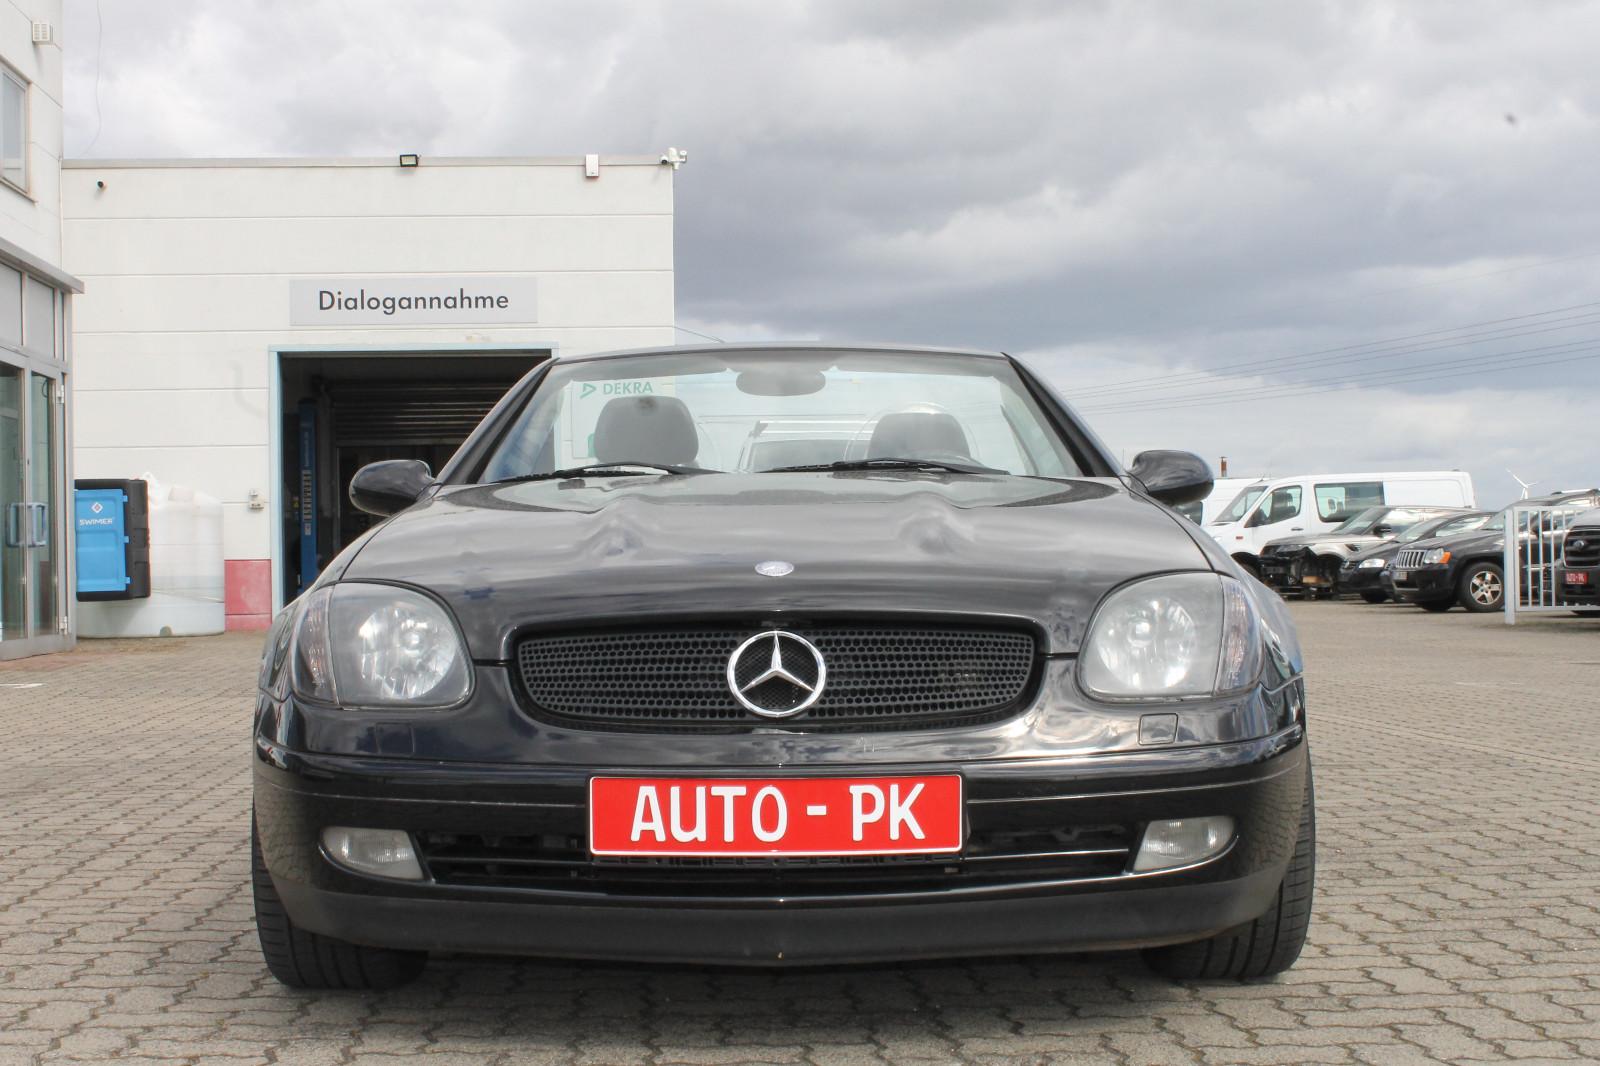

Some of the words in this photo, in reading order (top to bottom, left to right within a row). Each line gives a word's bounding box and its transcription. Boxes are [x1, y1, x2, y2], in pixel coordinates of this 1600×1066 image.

[318, 287, 510, 316] Dialogannahme
[602, 382, 654, 396] DEKRA
[630, 784, 788, 844] AUTO
[848, 782, 927, 842] PK
